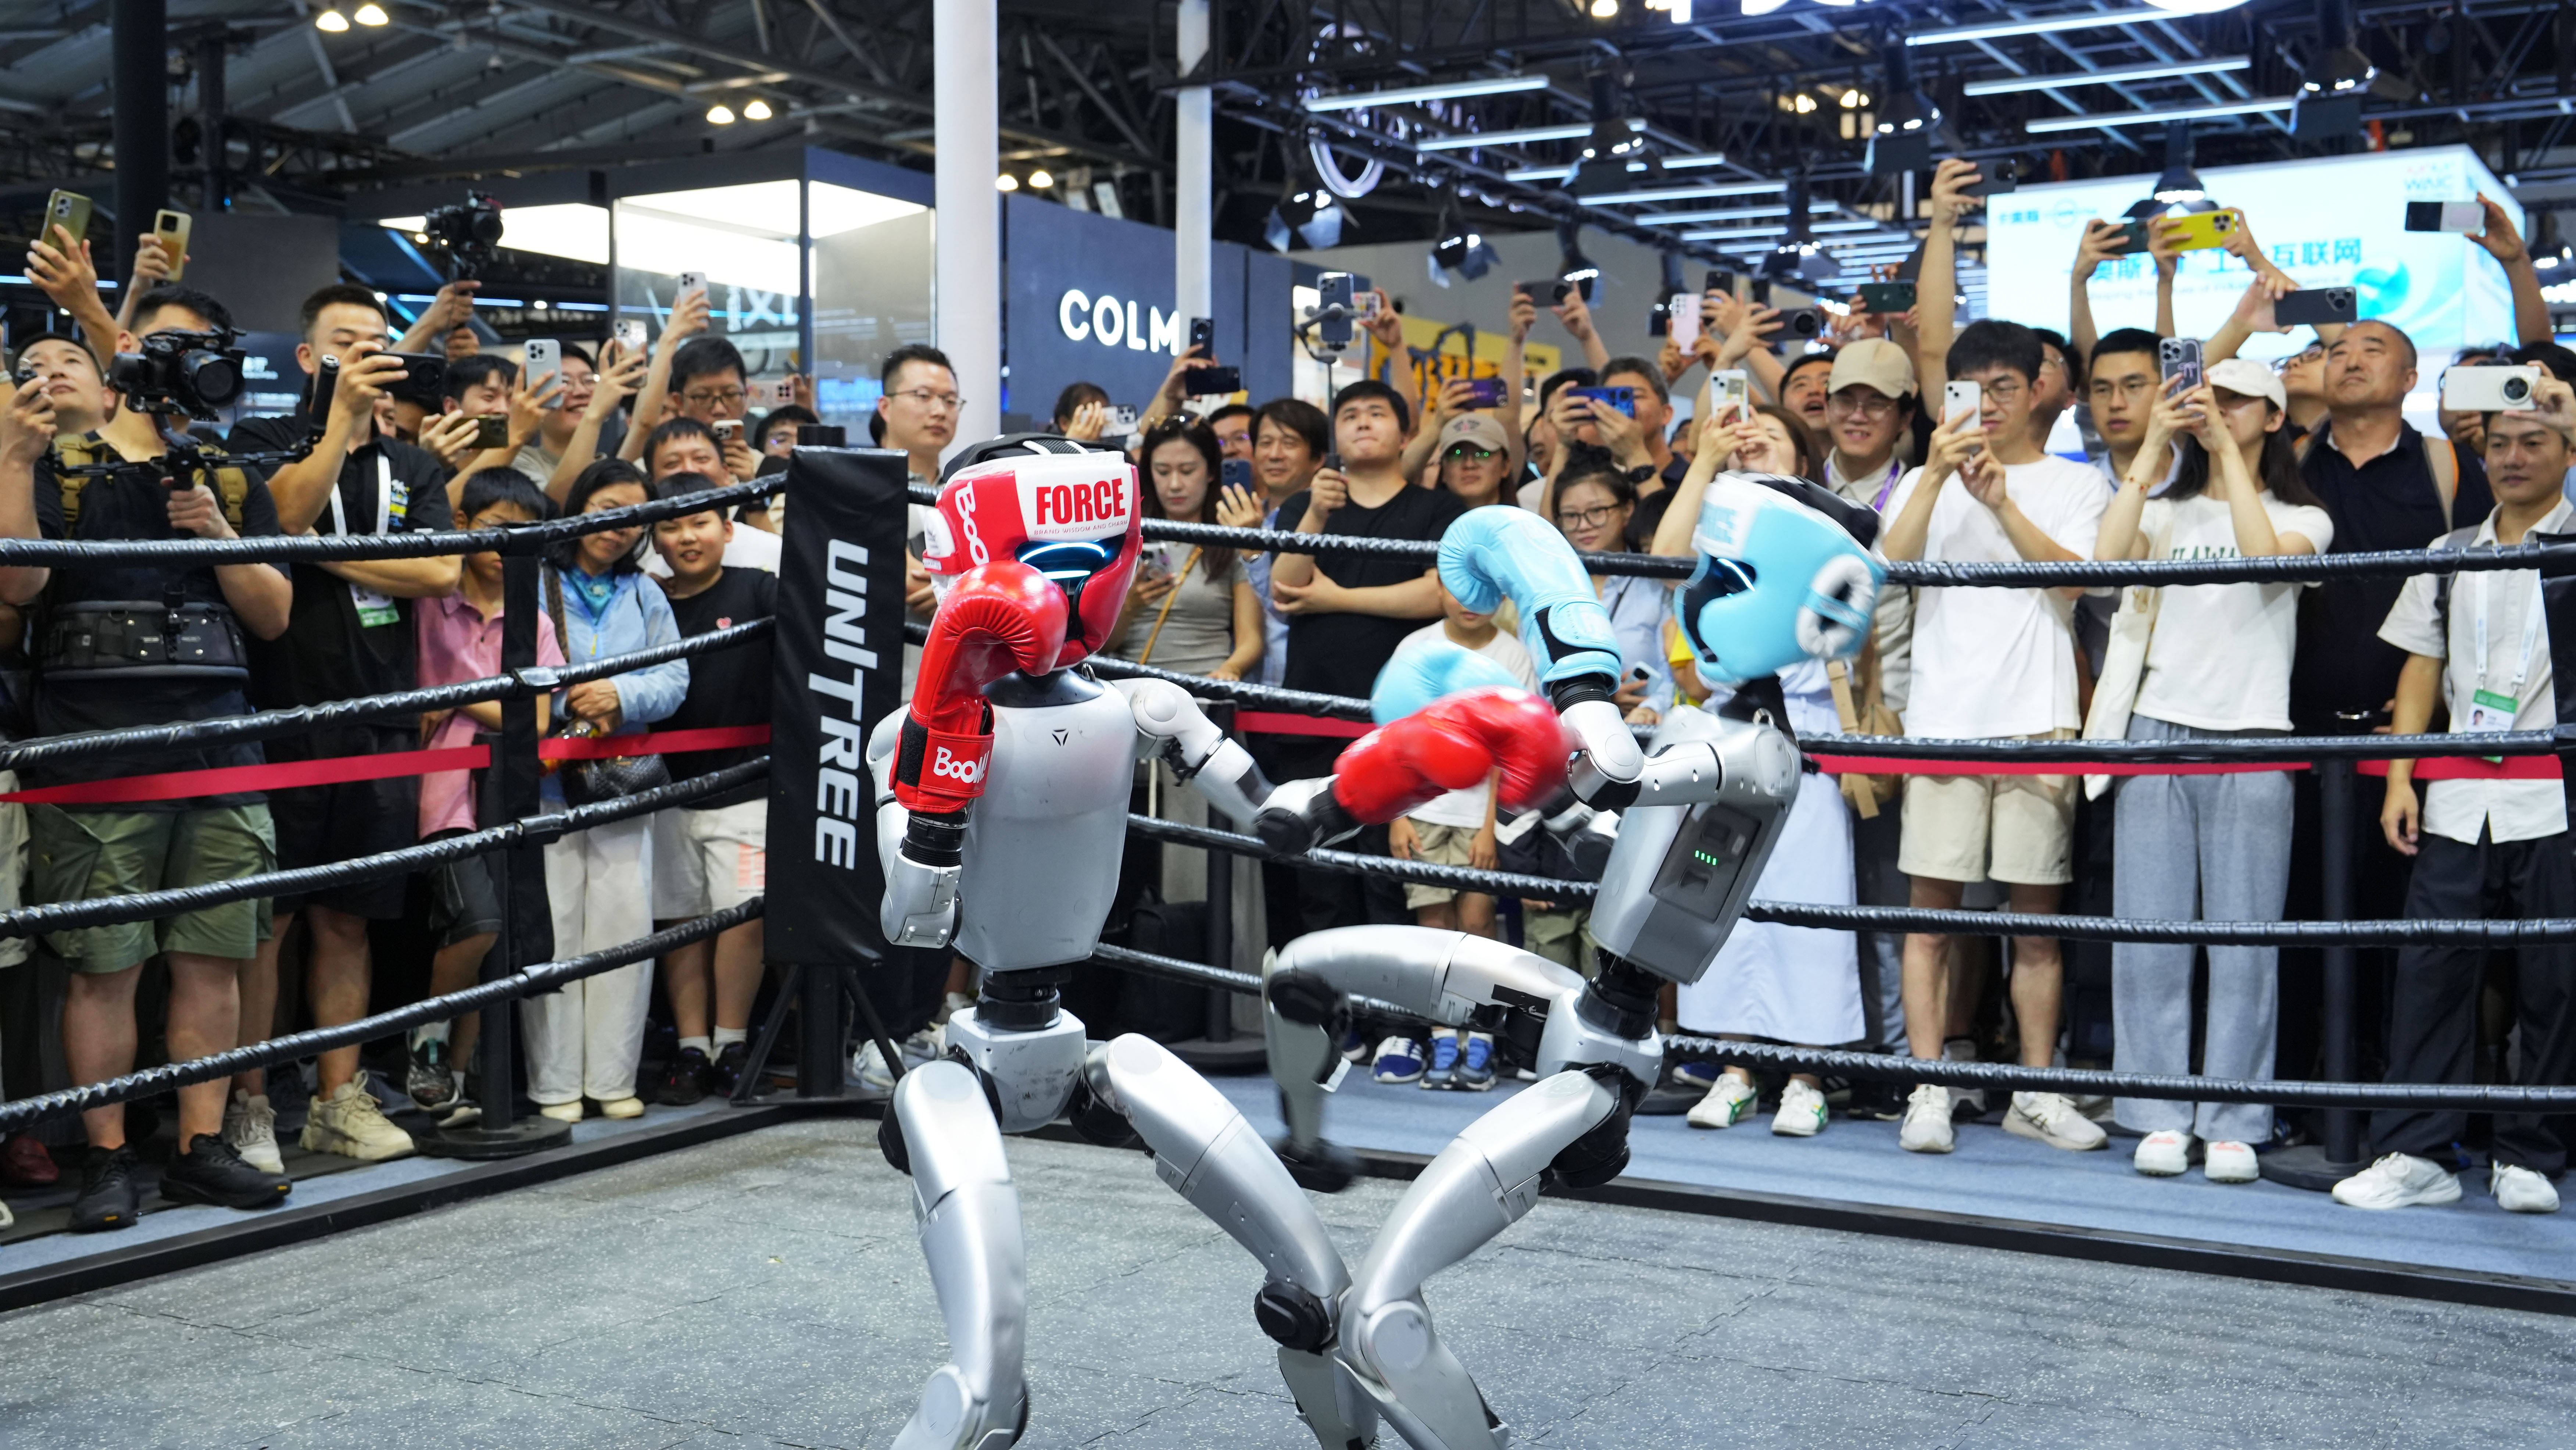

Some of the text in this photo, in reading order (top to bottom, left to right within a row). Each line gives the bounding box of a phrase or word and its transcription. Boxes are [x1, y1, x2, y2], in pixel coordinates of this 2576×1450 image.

[2208, 237, 2361, 274] 工互联网
[1060, 289, 1180, 356] COLM
[1037, 478, 1126, 525] FORCE
[1108, 519, 1128, 528] CHARM
[808, 538, 878, 870] UNITREE
